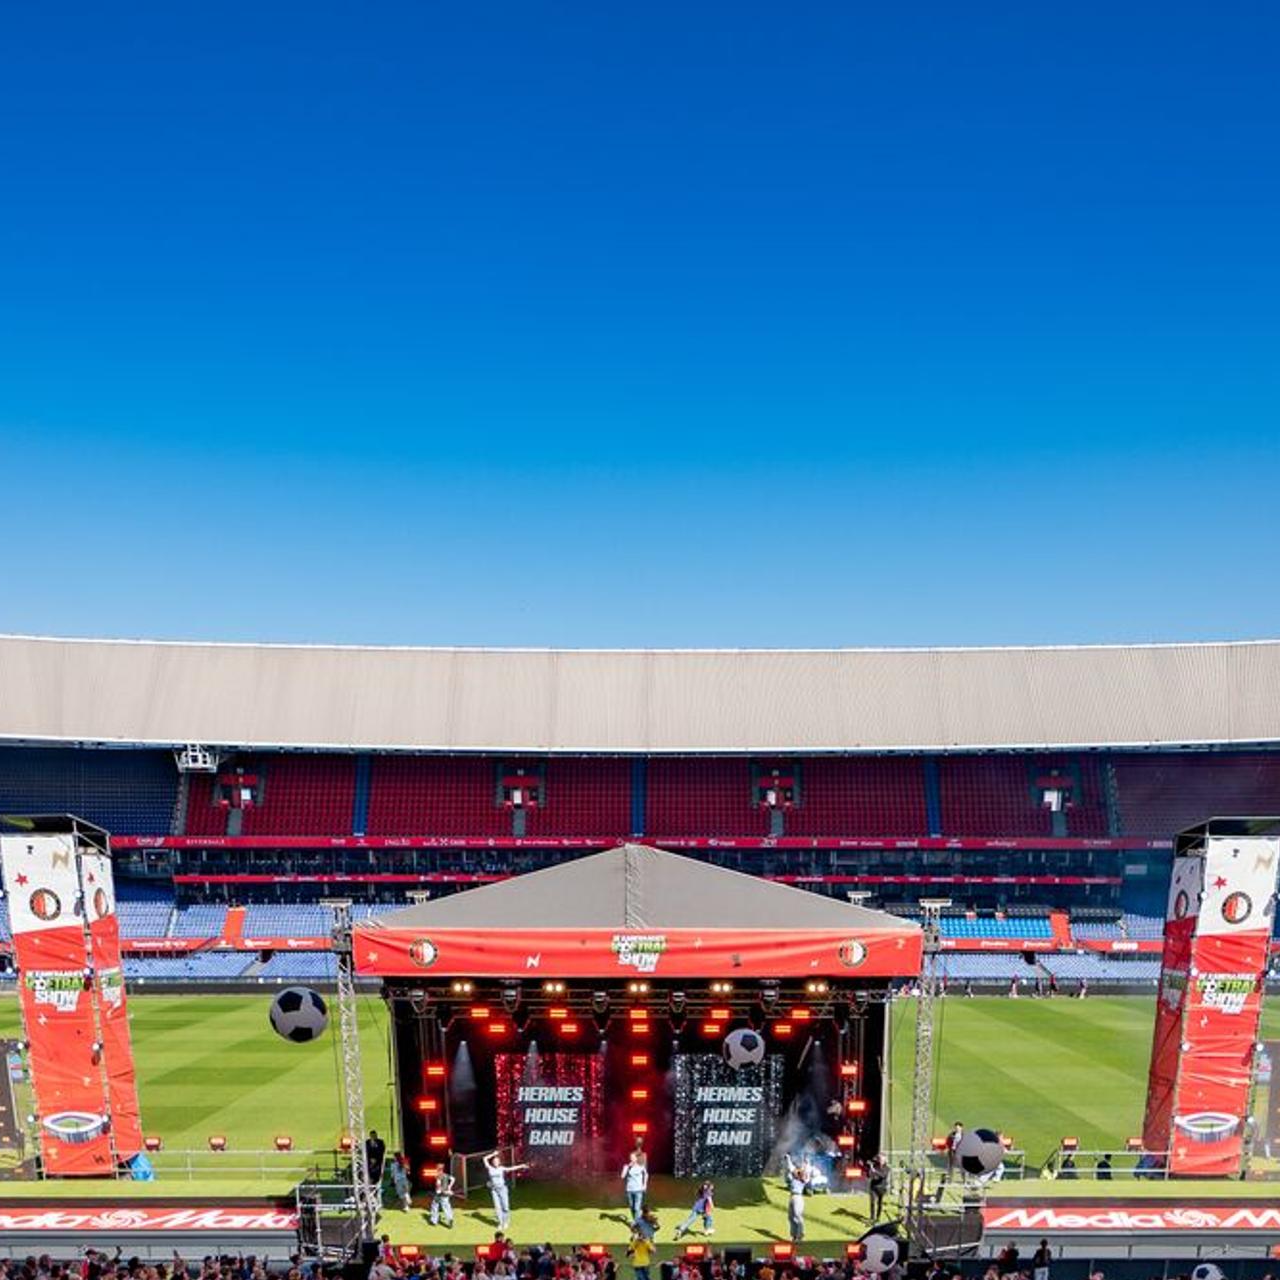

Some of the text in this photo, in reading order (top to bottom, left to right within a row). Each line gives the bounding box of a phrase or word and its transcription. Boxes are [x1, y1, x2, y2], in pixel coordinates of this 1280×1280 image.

[518, 1086, 585, 1102] HERMES
[696, 1086, 764, 1102] HERMES
[524, 1107, 579, 1124] HOUSE
[702, 1107, 758, 1124] HOUSE
[528, 1130, 576, 1146] BAND
[705, 1130, 753, 1146] BAND
[987, 1209, 1165, 1228] Media
